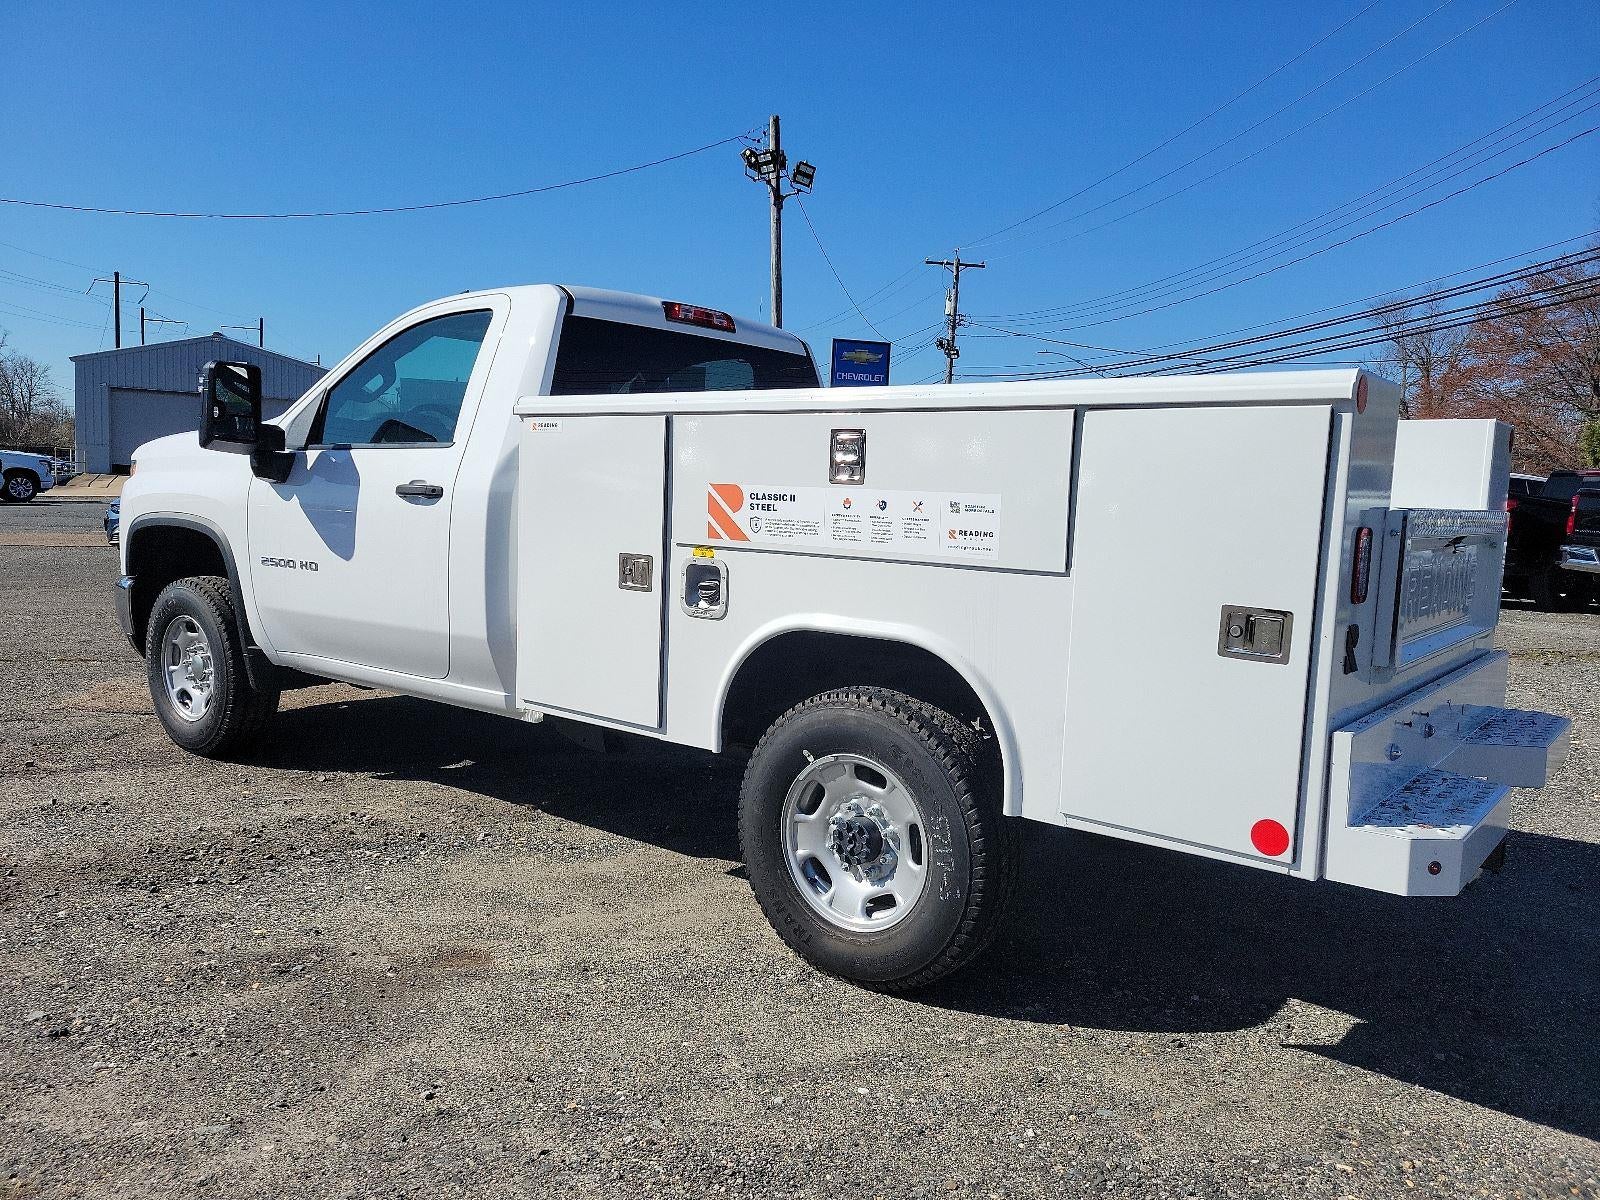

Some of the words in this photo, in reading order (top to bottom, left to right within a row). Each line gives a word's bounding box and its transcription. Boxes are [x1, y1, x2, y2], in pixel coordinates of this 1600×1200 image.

[836, 372, 884, 382] CHEVROLET
[749, 492, 788, 502] CLASSIC
[749, 503, 778, 512] STEEL
[958, 529, 994, 538] READING
[260, 556, 297, 569] 2500
[299, 560, 319, 571] HD
